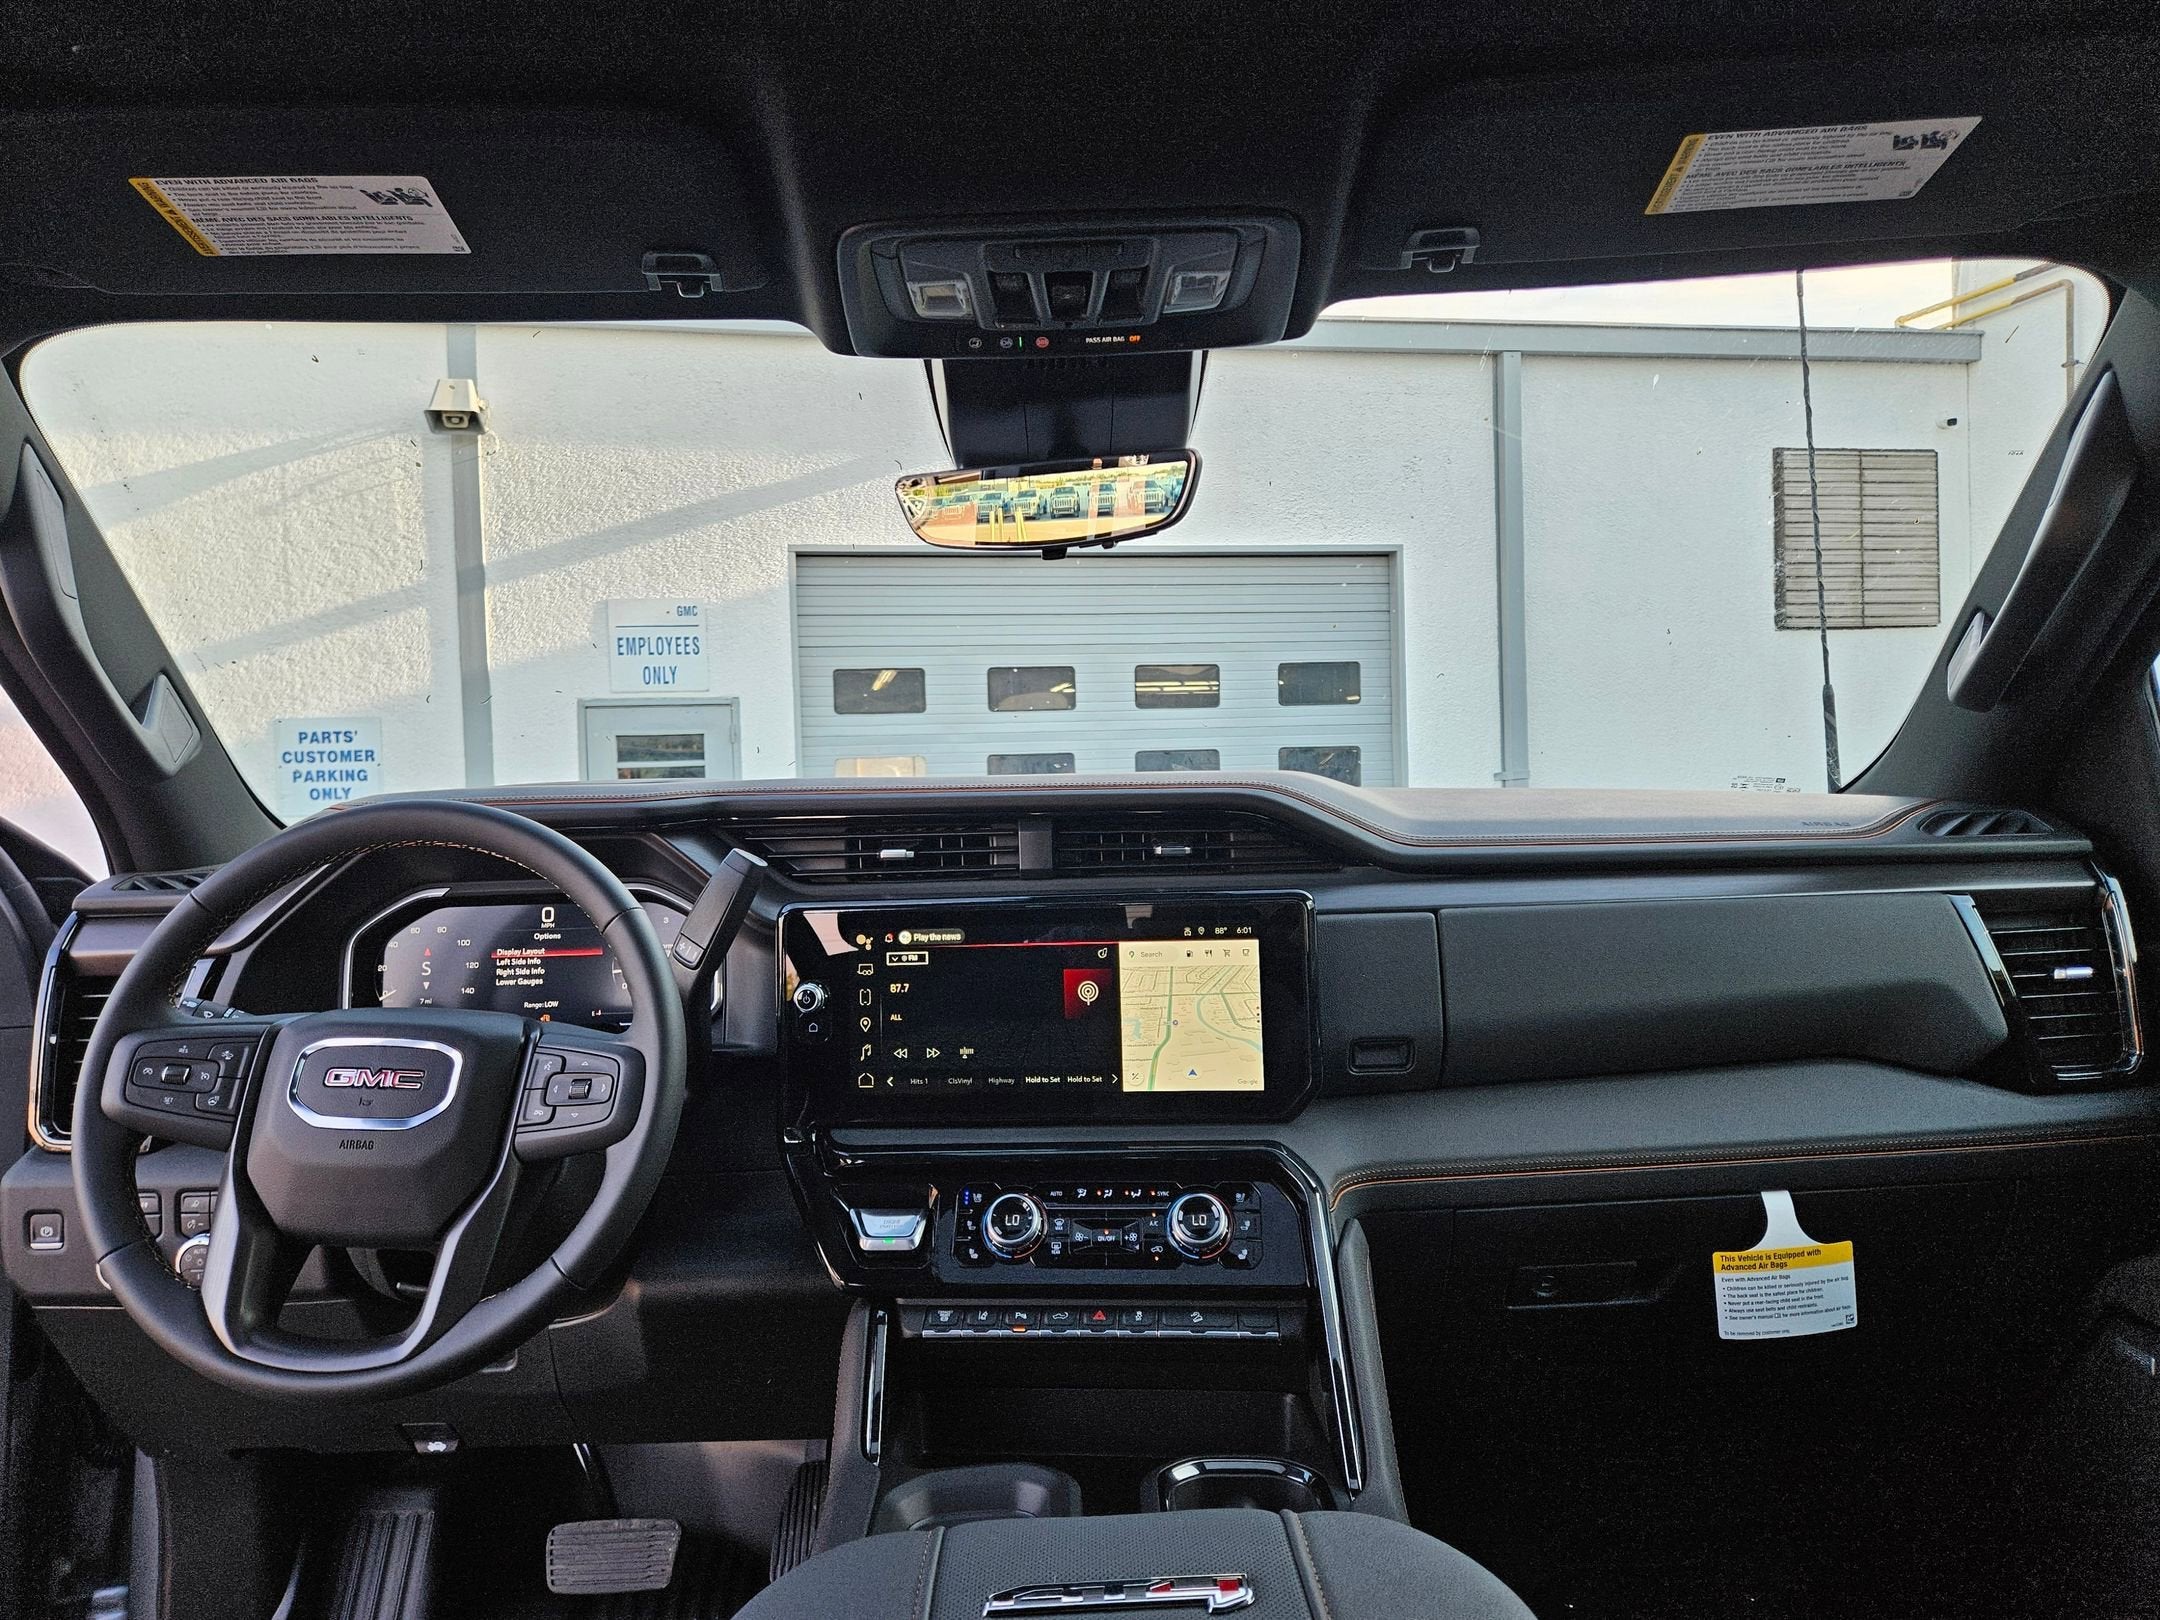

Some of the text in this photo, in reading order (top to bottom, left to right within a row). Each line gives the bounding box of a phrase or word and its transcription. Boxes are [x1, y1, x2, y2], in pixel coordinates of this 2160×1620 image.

[676, 605, 698, 616] GMC
[617, 636, 700, 656] EMPLOYEES
[642, 666, 677, 685] ONLY
[282, 750, 375, 764] CUSTOMER
[292, 769, 368, 783] PARKING
[310, 787, 352, 801] ONLY
[541, 906, 555, 923] 0
[534, 932, 561, 941] Options
[913, 933, 961, 942] Play the news
[457, 939, 471, 947] 100
[496, 947, 546, 957] Display Layout
[496, 958, 510, 966] Left
[512, 958, 526, 966] Side
[378, 964, 388, 972] 20
[421, 961, 431, 976] S
[496, 967, 545, 978] Right Side Info
[496, 978, 543, 987] Lower Gauges
[890, 983, 910, 993] 87.7
[324, 1068, 424, 1089] GMC
[988, 1077, 1015, 1086] Highway
[1025, 1076, 1040, 1084] Hold
[1050, 1076, 1060, 1084] Set
[1067, 1076, 1082, 1084] Hold
[339, 1140, 374, 1150] AIRBAG
[1738, 1254, 1763, 1262] Vehicle
[1774, 1250, 1805, 1260] Equipped
[1807, 1249, 1822, 1257] with
[1721, 1261, 1788, 1271] Advanced Air Bags
